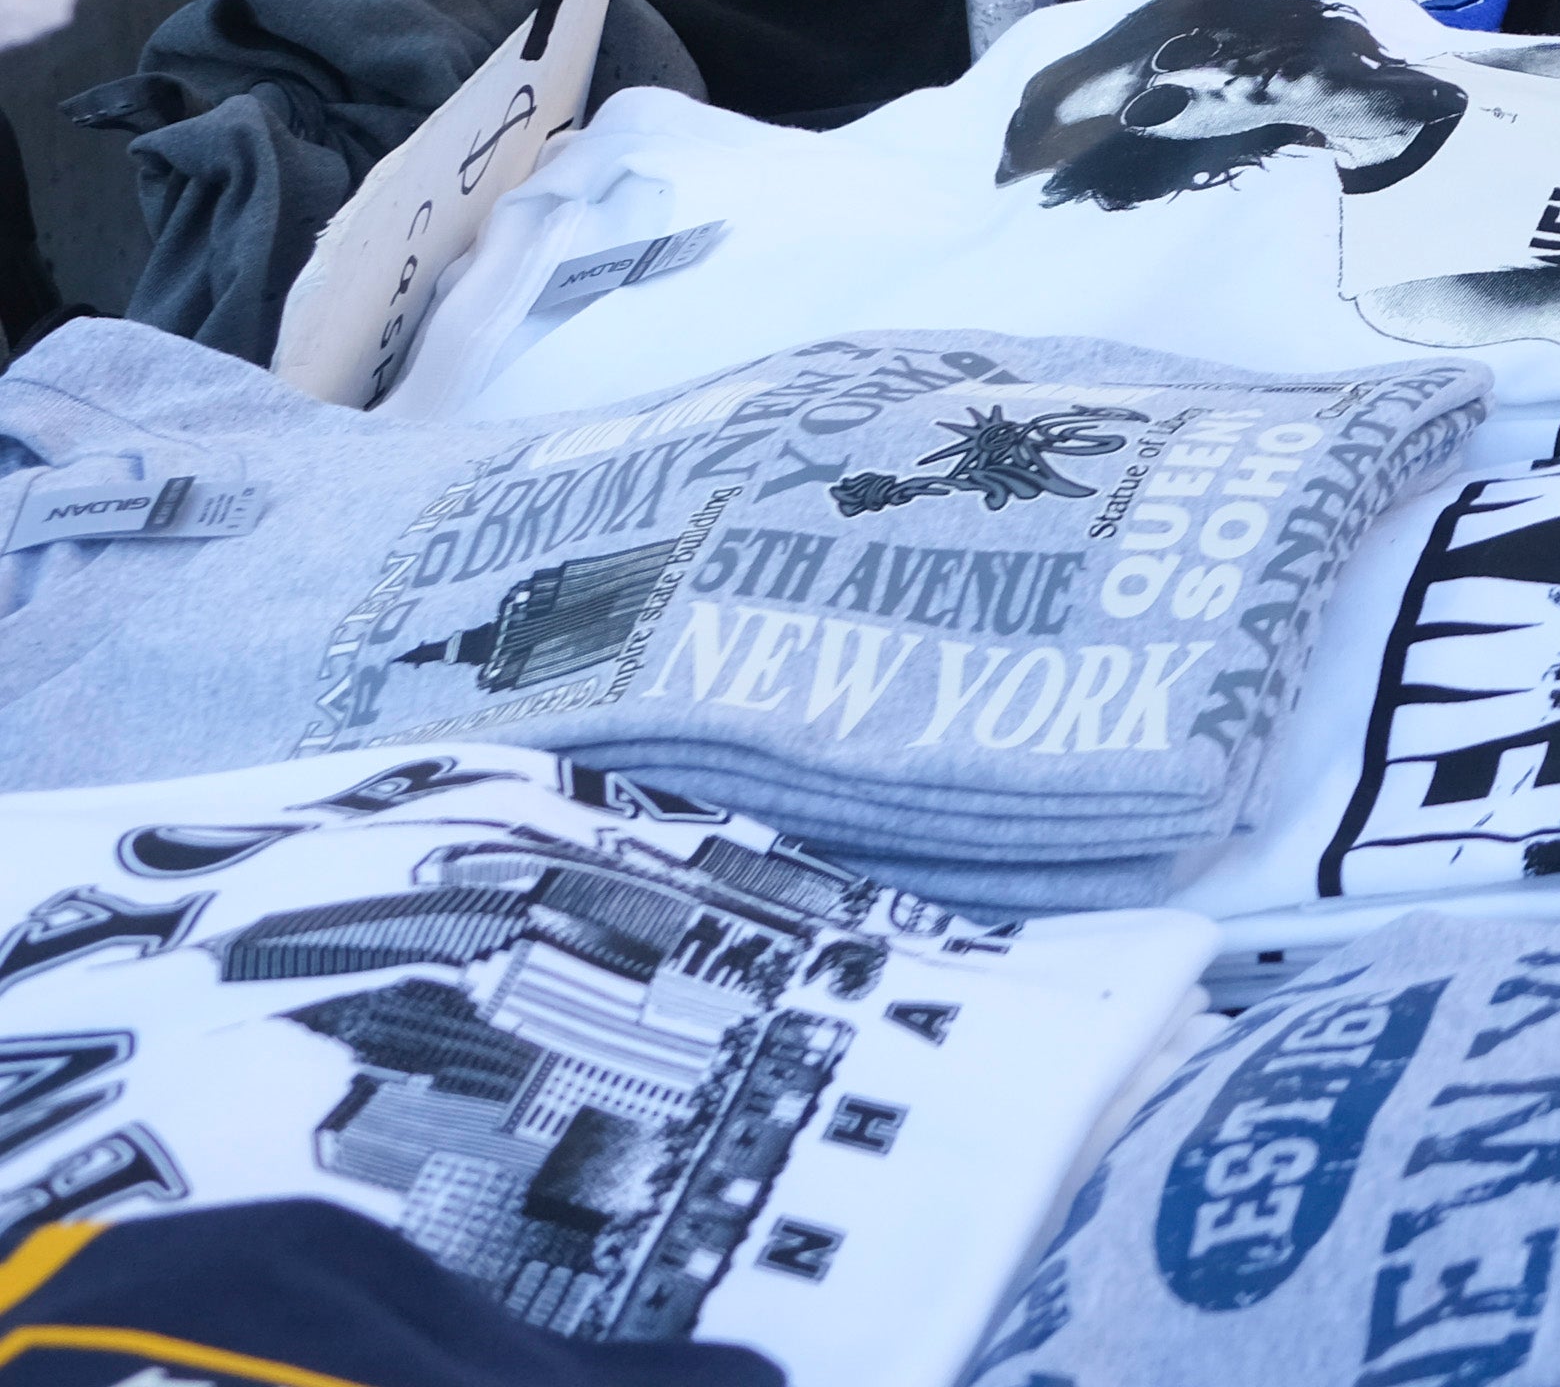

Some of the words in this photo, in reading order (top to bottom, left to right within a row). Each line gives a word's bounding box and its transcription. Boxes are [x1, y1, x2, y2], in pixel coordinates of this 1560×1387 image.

[562, 256, 636, 289] GILDAN
[681, 367, 857, 490] NEW
[752, 352, 970, 504] YORK
[1089, 464, 1150, 541] Statue
[1138, 437, 1168, 459] of
[44, 491, 152, 524] GILDAN
[453, 430, 706, 585] BRONX
[668, 482, 746, 568] Building
[689, 525, 828, 603] 5TH
[832, 542, 1090, 641] AVENUE
[1170, 422, 1325, 623] SOHO
[1186, 363, 1470, 761] MANHATTAN
[296, 549, 420, 760] TATEN
[640, 598, 924, 742] NEW
[904, 636, 1217, 755] YORK
[1189, 1000, 1396, 1258] EST.16
